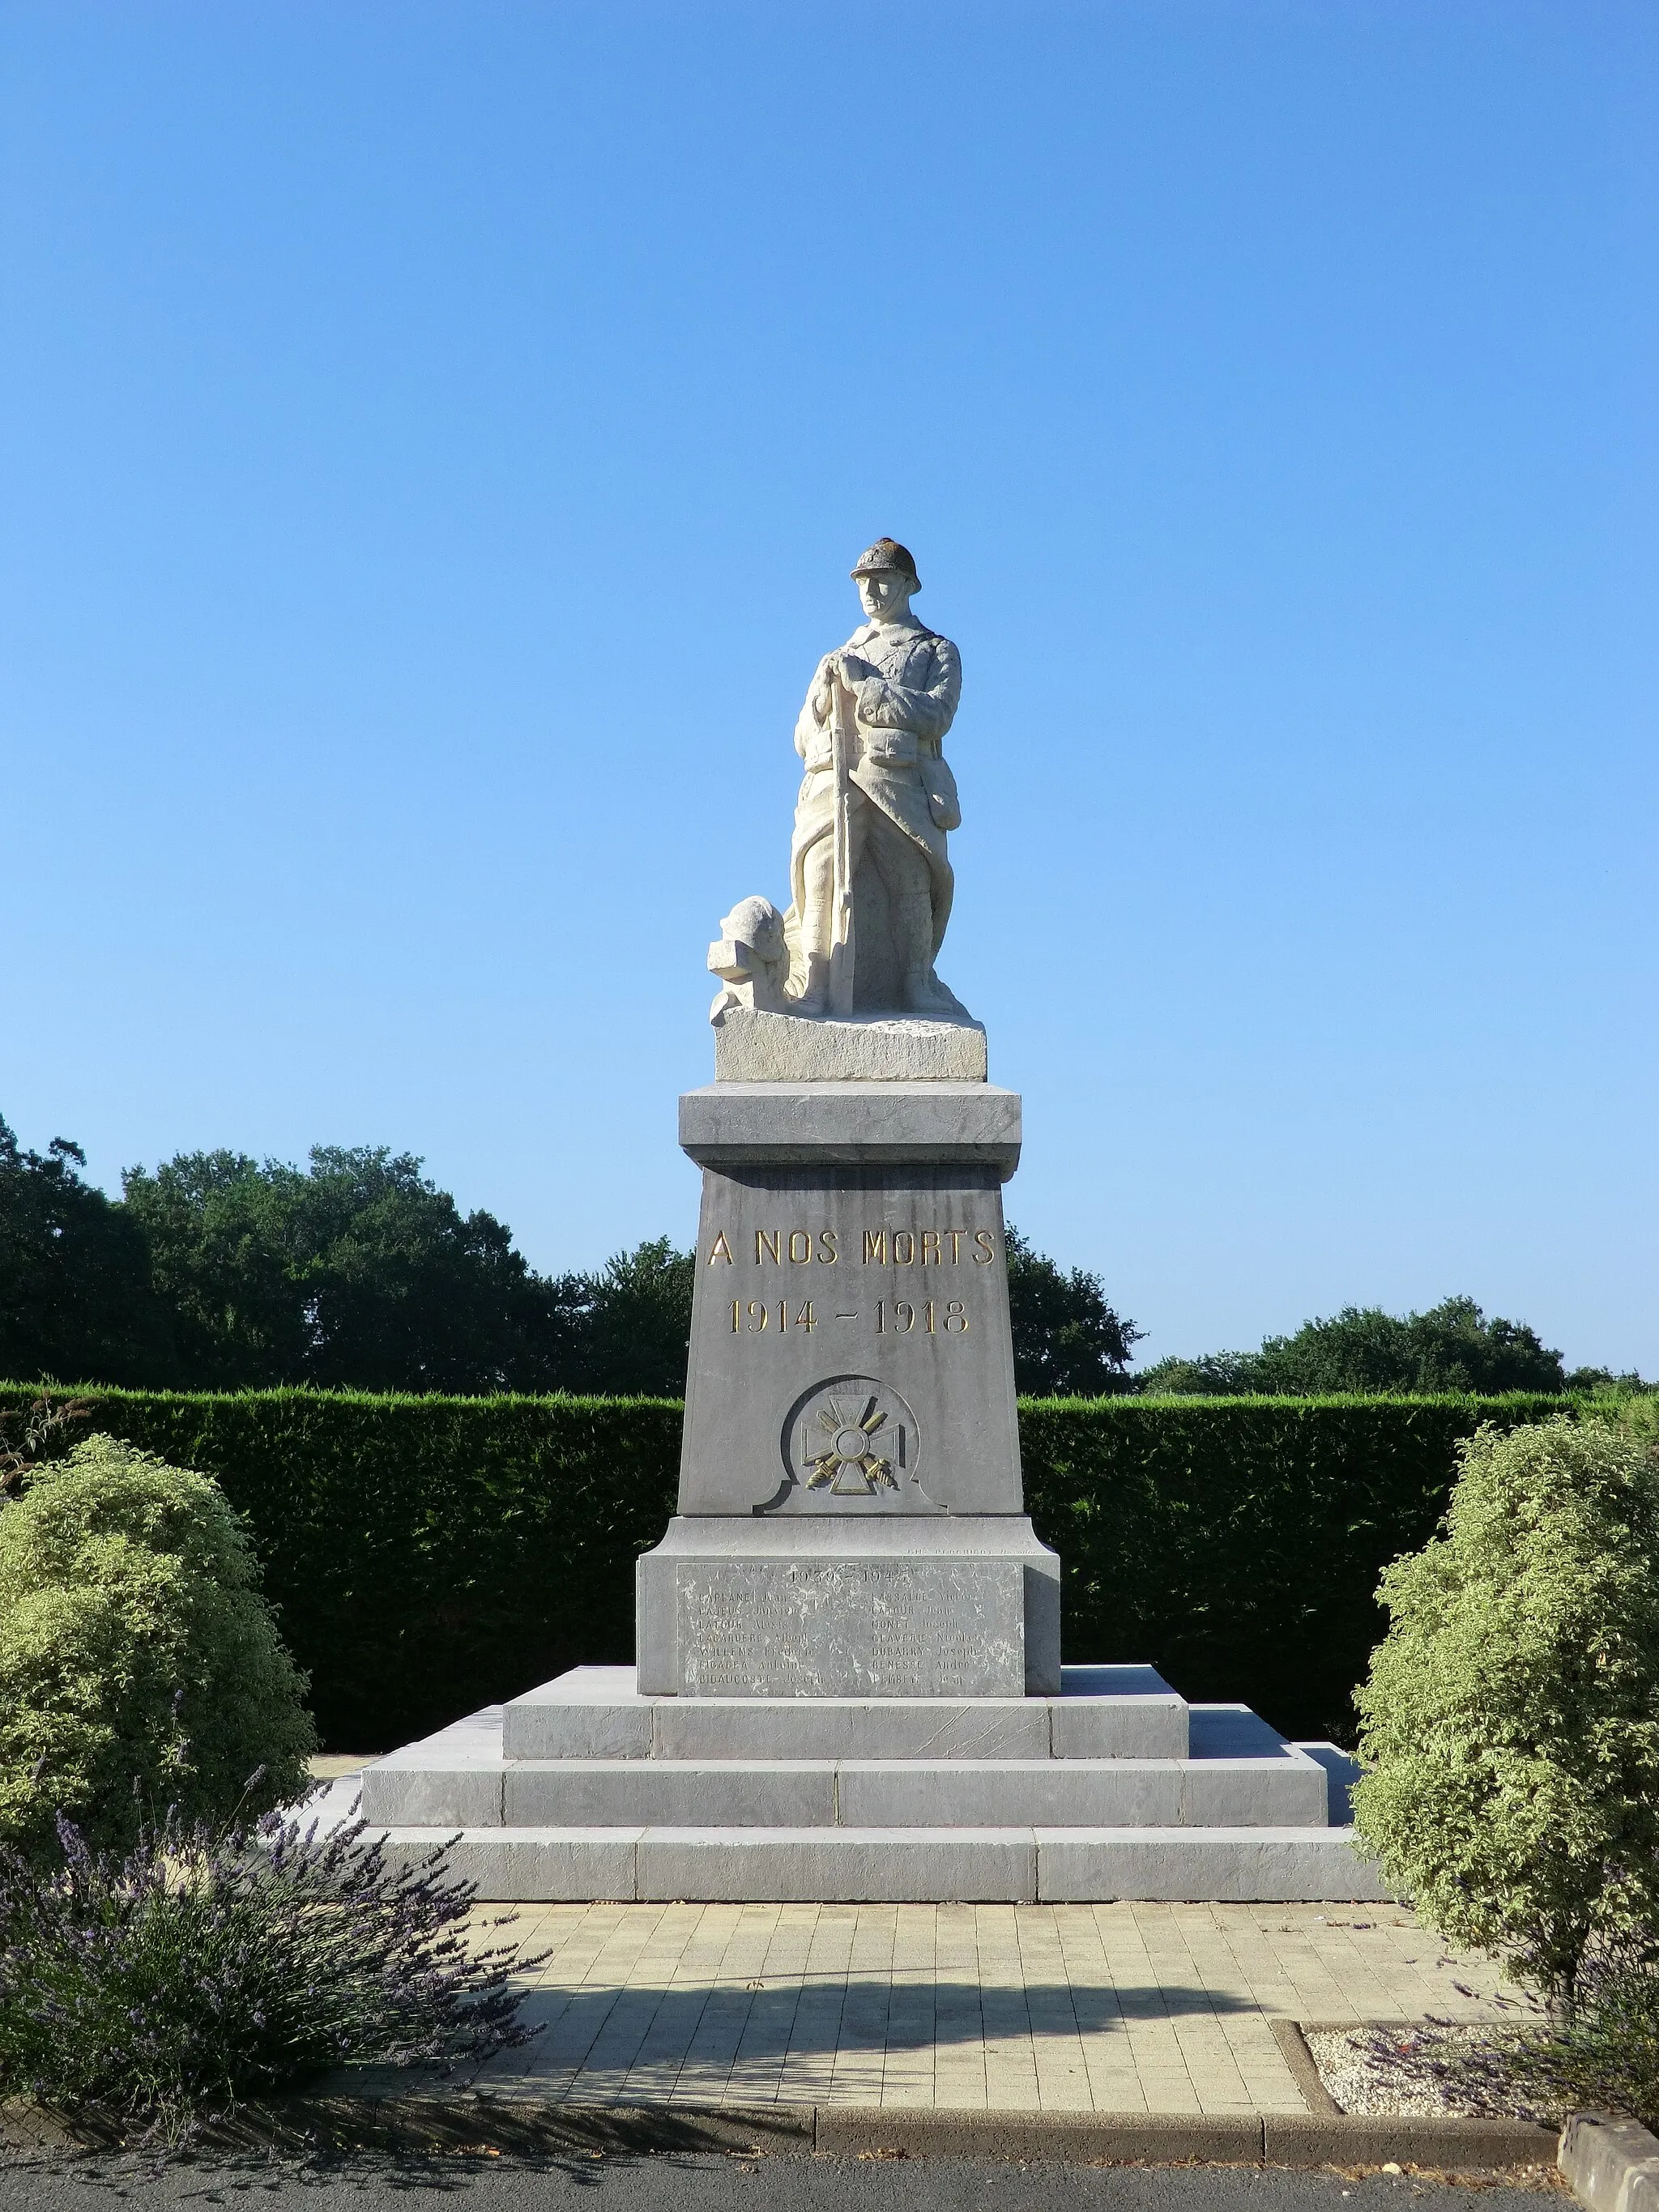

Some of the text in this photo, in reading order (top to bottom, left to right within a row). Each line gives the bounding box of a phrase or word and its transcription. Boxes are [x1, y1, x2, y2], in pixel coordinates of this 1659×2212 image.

[707, 1230, 996, 1266] A NOS MORTS
[727, 1300, 819, 1335] 1914
[873, 1300, 969, 1335] 1918
[791, 1571, 835, 1583] 1939
[872, 1606, 915, 1615] LATOUR
[698, 1620, 743, 1630] LATOUR
[872, 1646, 978, 1658] DUBARRY Joseph
